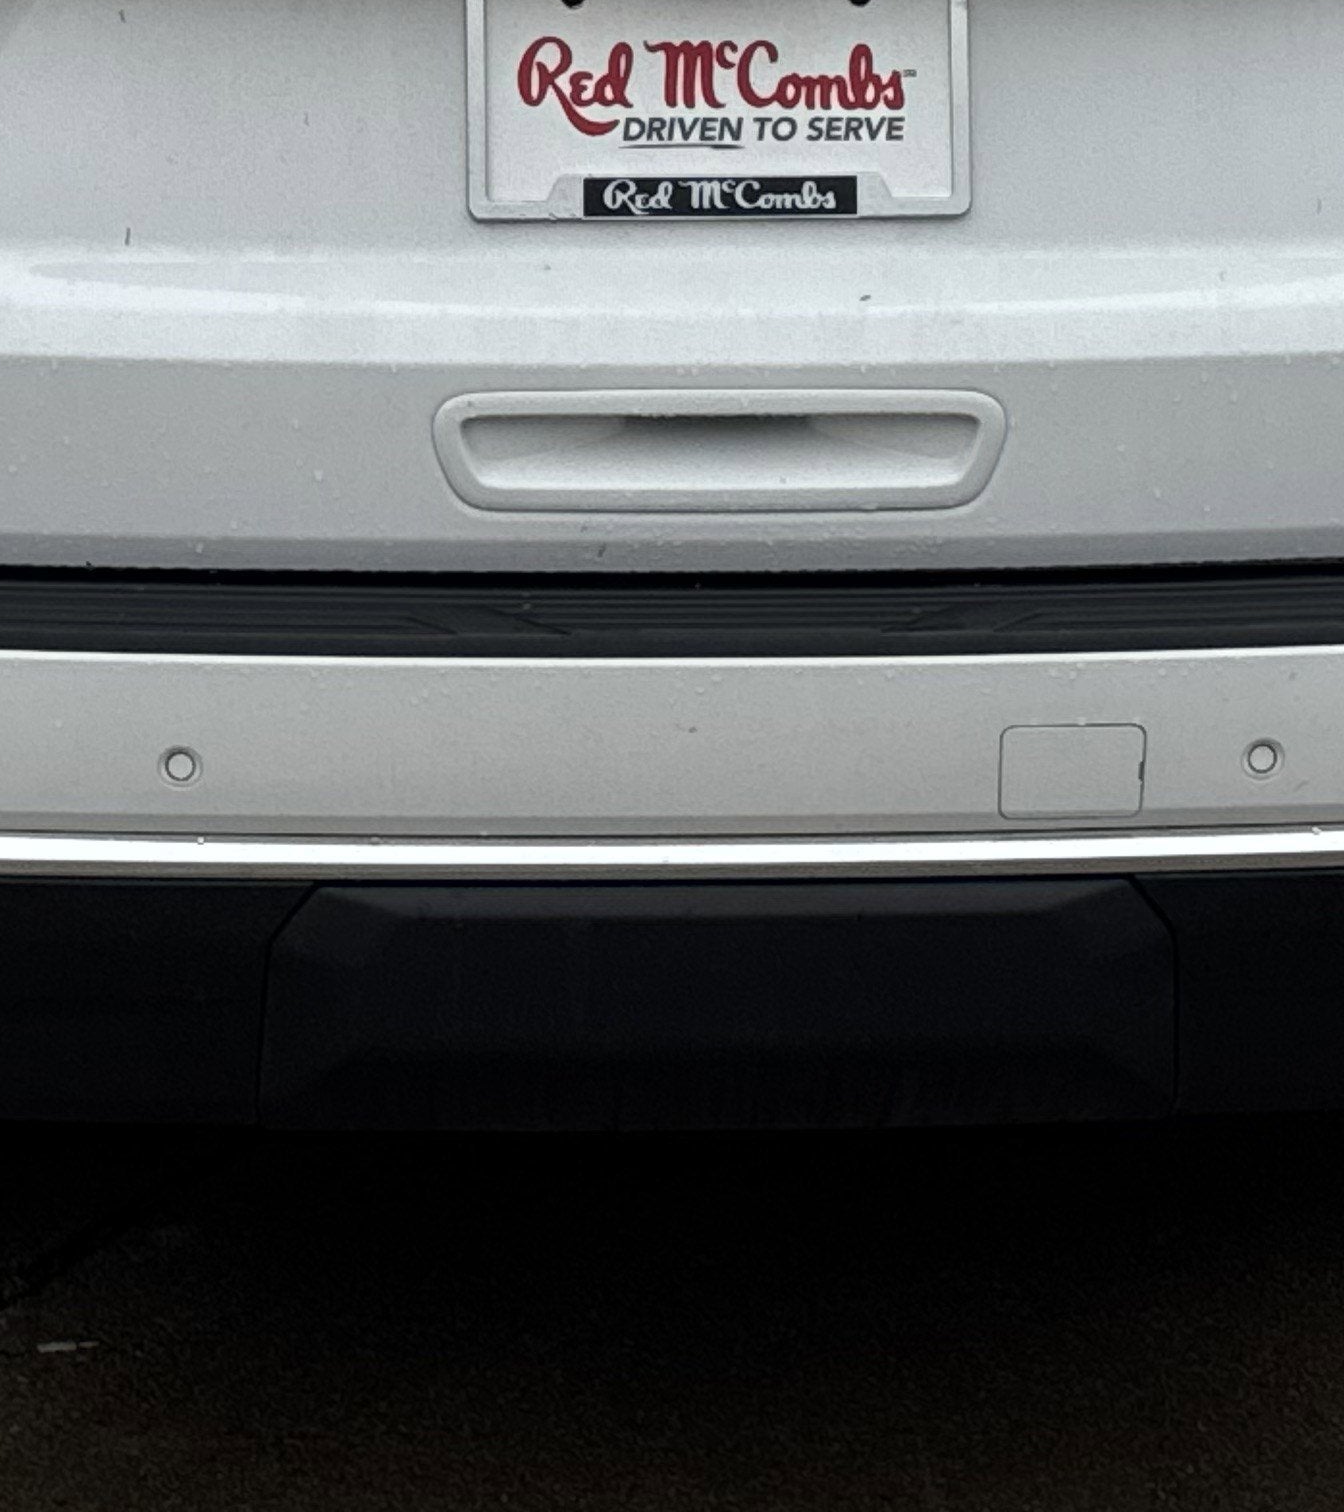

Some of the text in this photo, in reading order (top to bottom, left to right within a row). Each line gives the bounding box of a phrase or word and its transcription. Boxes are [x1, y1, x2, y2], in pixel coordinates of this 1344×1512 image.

[518, 36, 905, 136] Red McCombs
[622, 117, 905, 142] DRIVEN TO SERVE
[602, 179, 837, 216] Red McCombs
